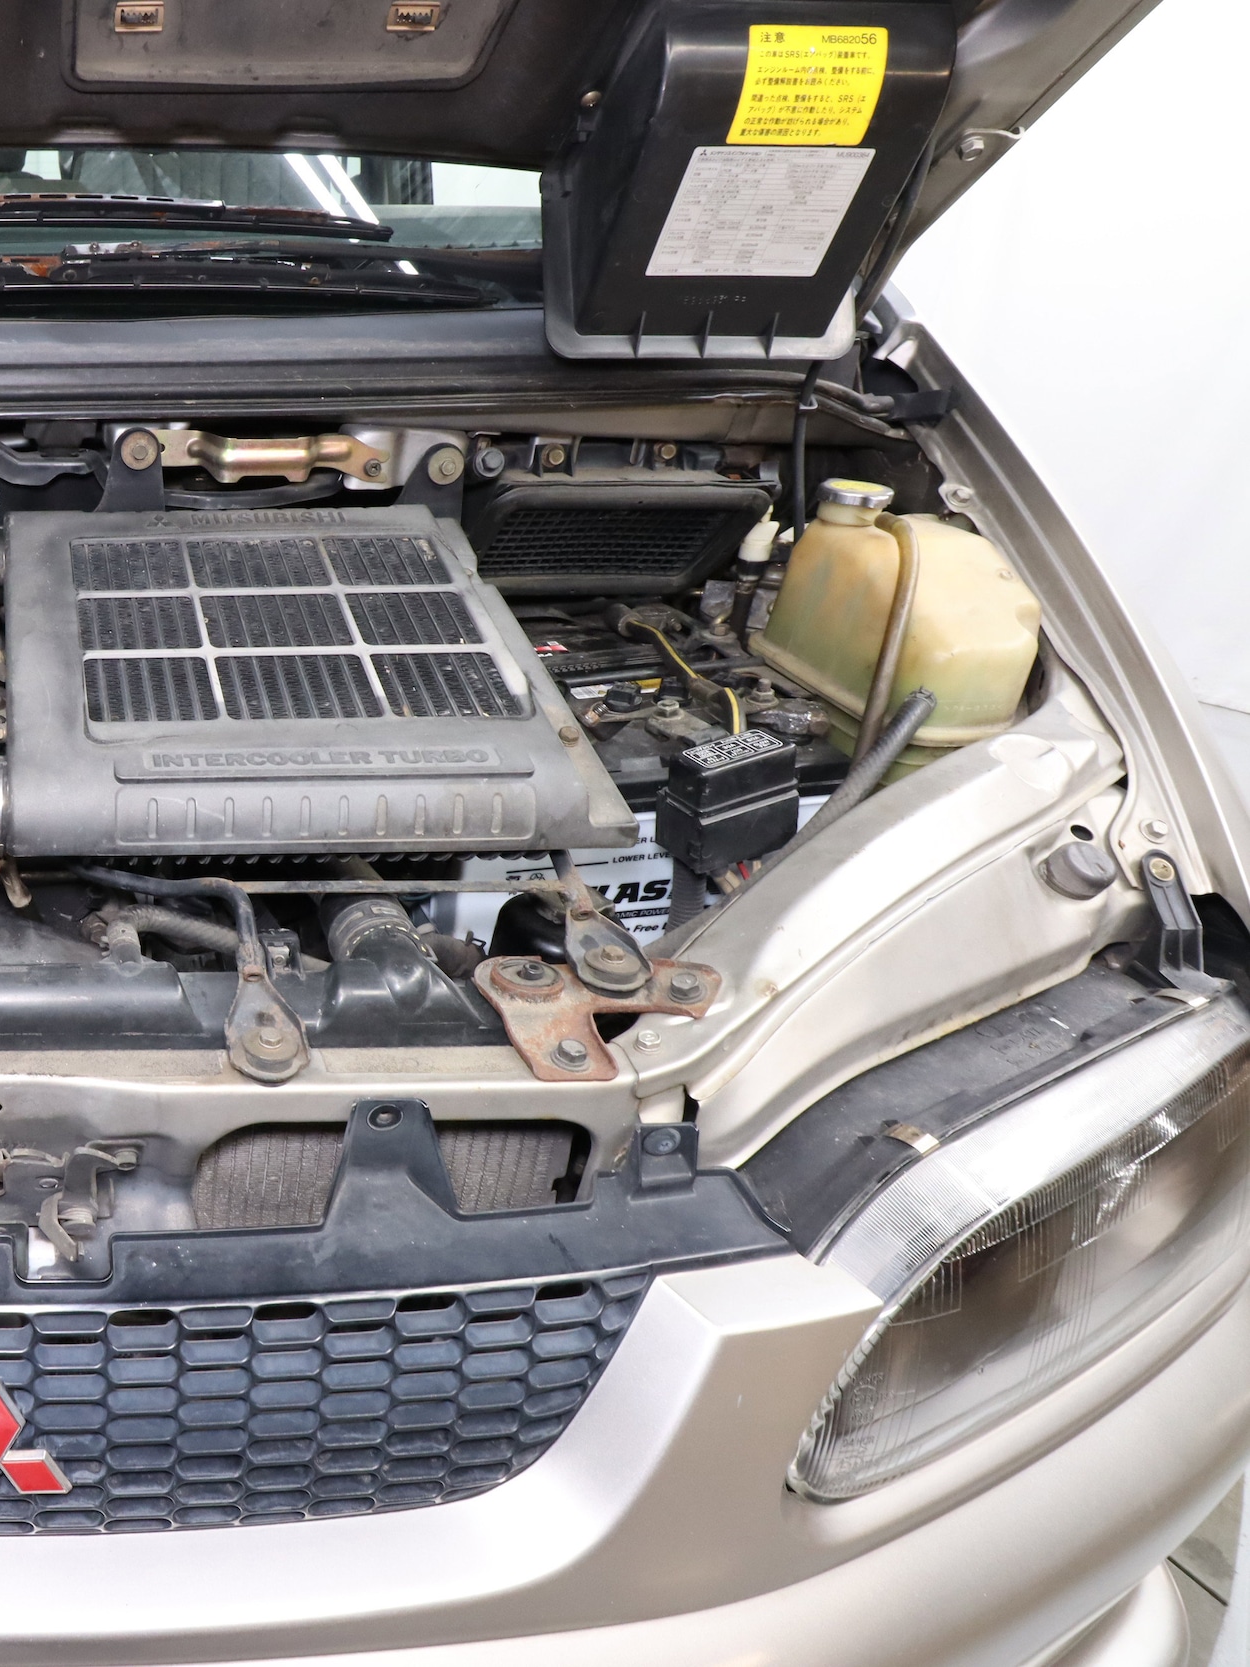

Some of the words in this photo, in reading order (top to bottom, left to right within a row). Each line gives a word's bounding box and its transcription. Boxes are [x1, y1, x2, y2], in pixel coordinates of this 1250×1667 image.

[760, 32, 785, 43] 注意
[821, 33, 877, 45] MB682056
[191, 511, 346, 525] MITSUBISHI
[152, 750, 373, 768] INTERCOOLER
[377, 749, 489, 764] TURBO
[612, 854, 645, 863] LOWER
[647, 852, 671, 860] LEVE
[633, 924, 659, 933] Free
